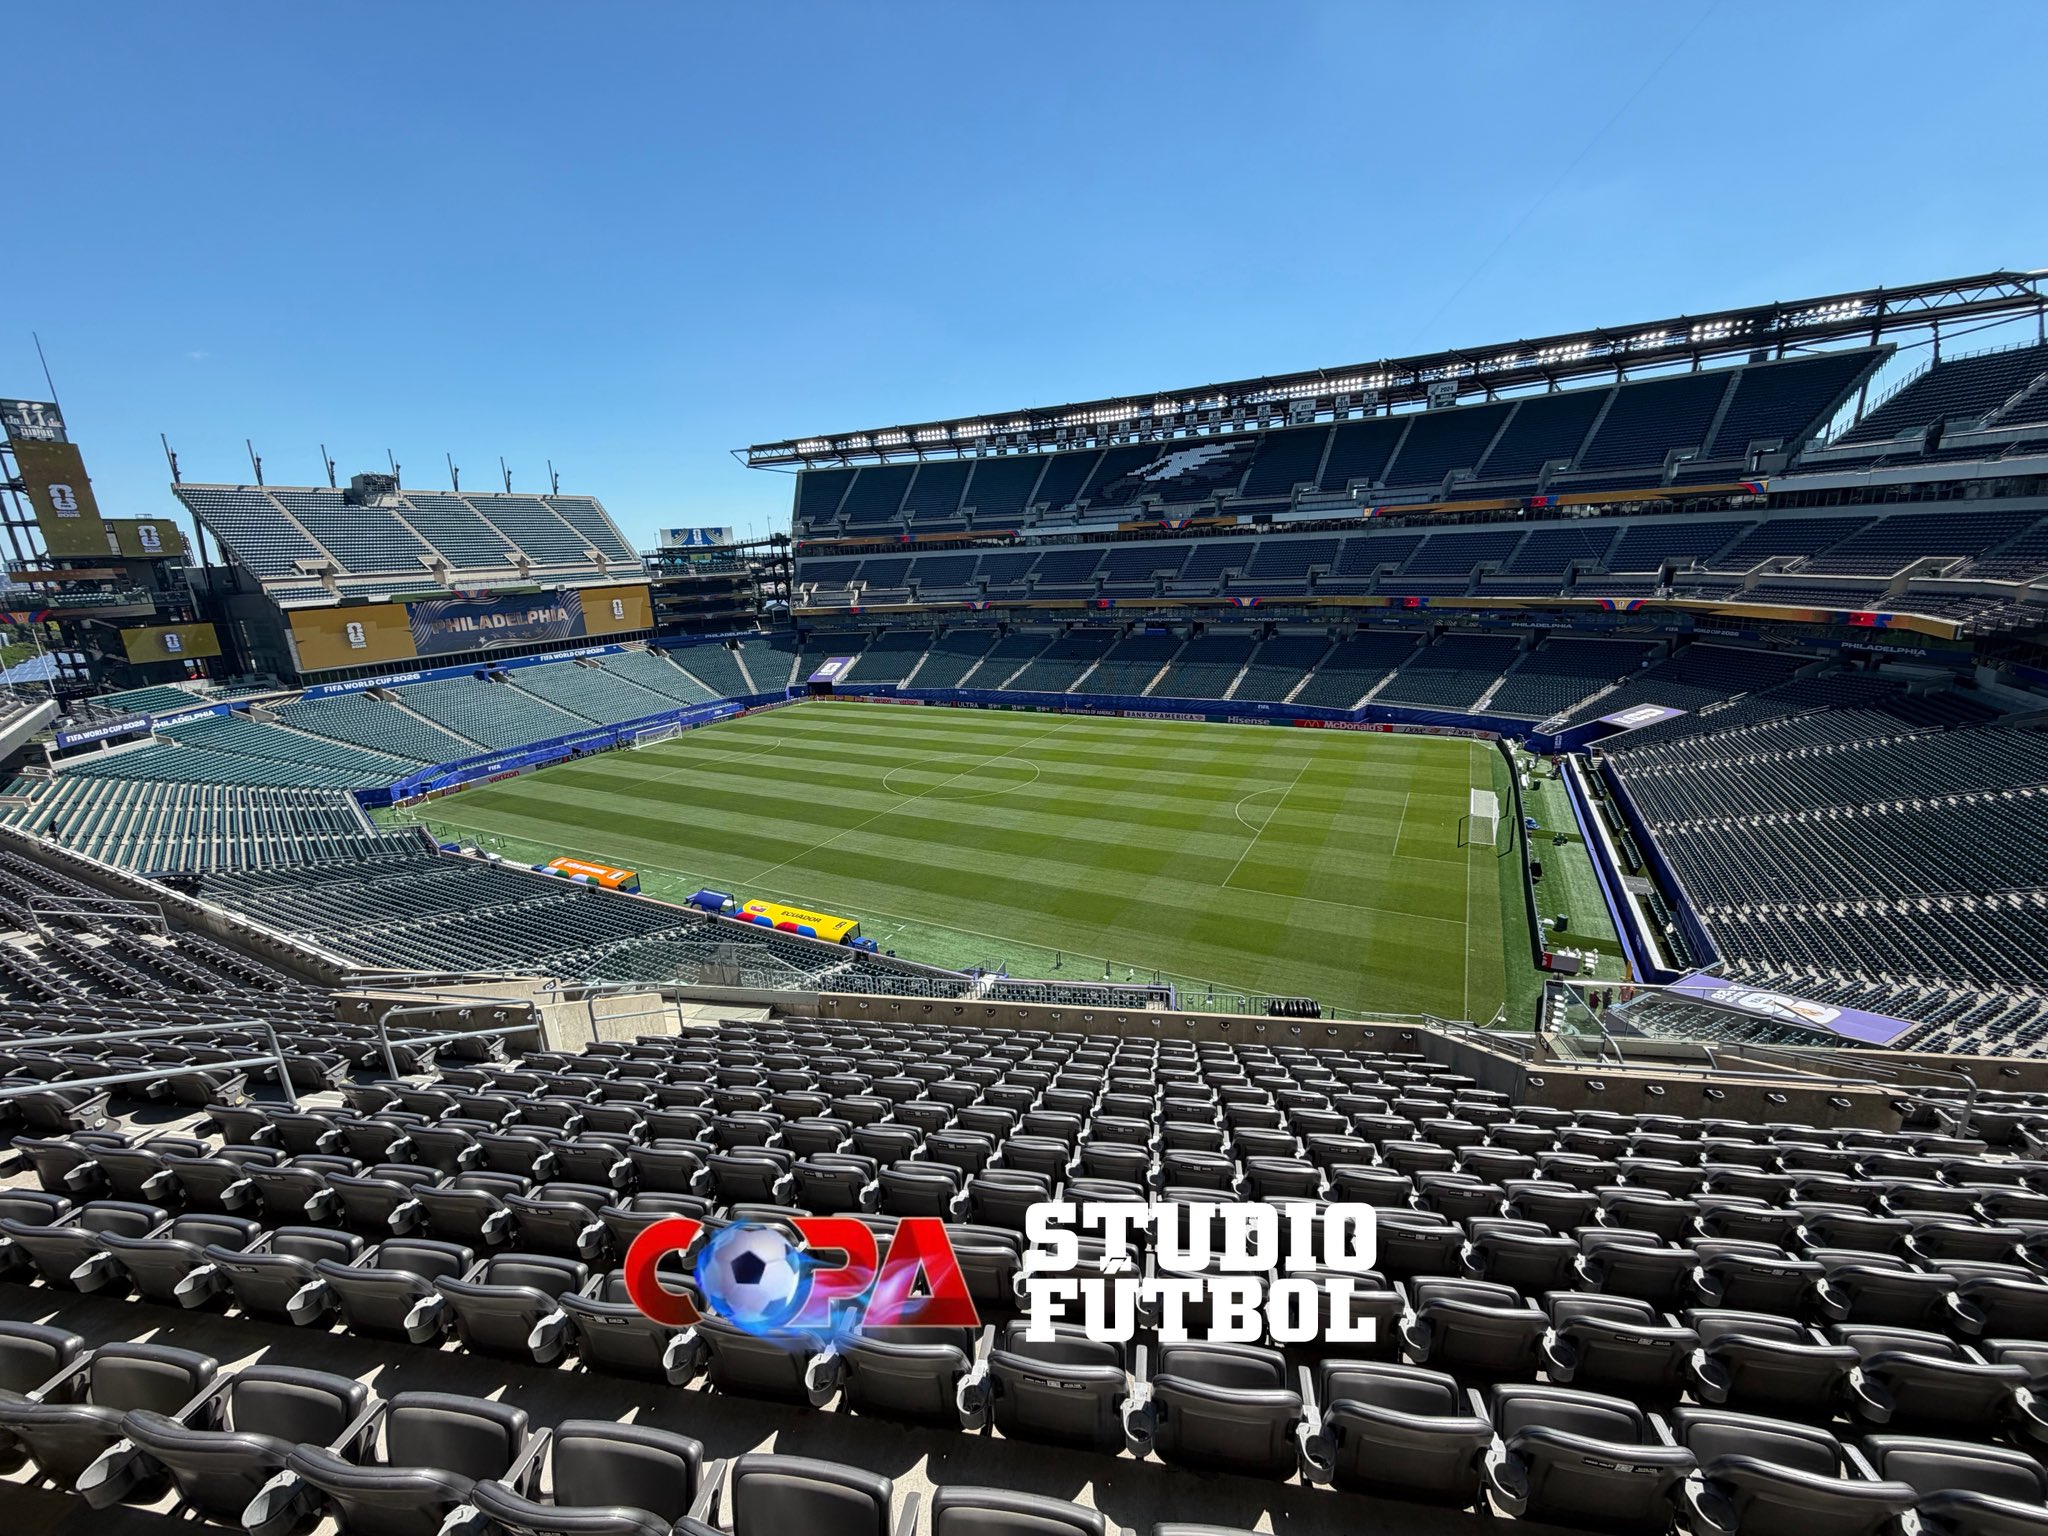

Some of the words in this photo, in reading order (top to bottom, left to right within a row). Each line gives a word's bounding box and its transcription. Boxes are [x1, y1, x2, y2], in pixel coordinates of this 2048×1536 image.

[431, 607, 569, 635] PHILADELPHIA
[1511, 622, 1573, 630] PHILADELPHIA
[1841, 641, 1927, 656] PHILADELPHIA
[553, 652, 575, 660] WORLD
[324, 685, 344, 693] FIFA
[343, 680, 375, 690] WORLD
[376, 677, 392, 685] CUP
[392, 673, 421, 683] 2026
[152, 710, 215, 729] PHILADELPHIA
[1228, 716, 1270, 726] Hisense
[66, 734, 84, 743] FIFA
[83, 728, 108, 739] WORLD
[109, 724, 123, 734] CUP
[123, 720, 147, 730] 2026
[1323, 721, 1384, 732] McDonald's
[569, 750, 593, 761] ULTRA
[487, 764, 501, 772] FIFA
[488, 770, 520, 784] verizon
[781, 911, 822, 924] ECUADOR
